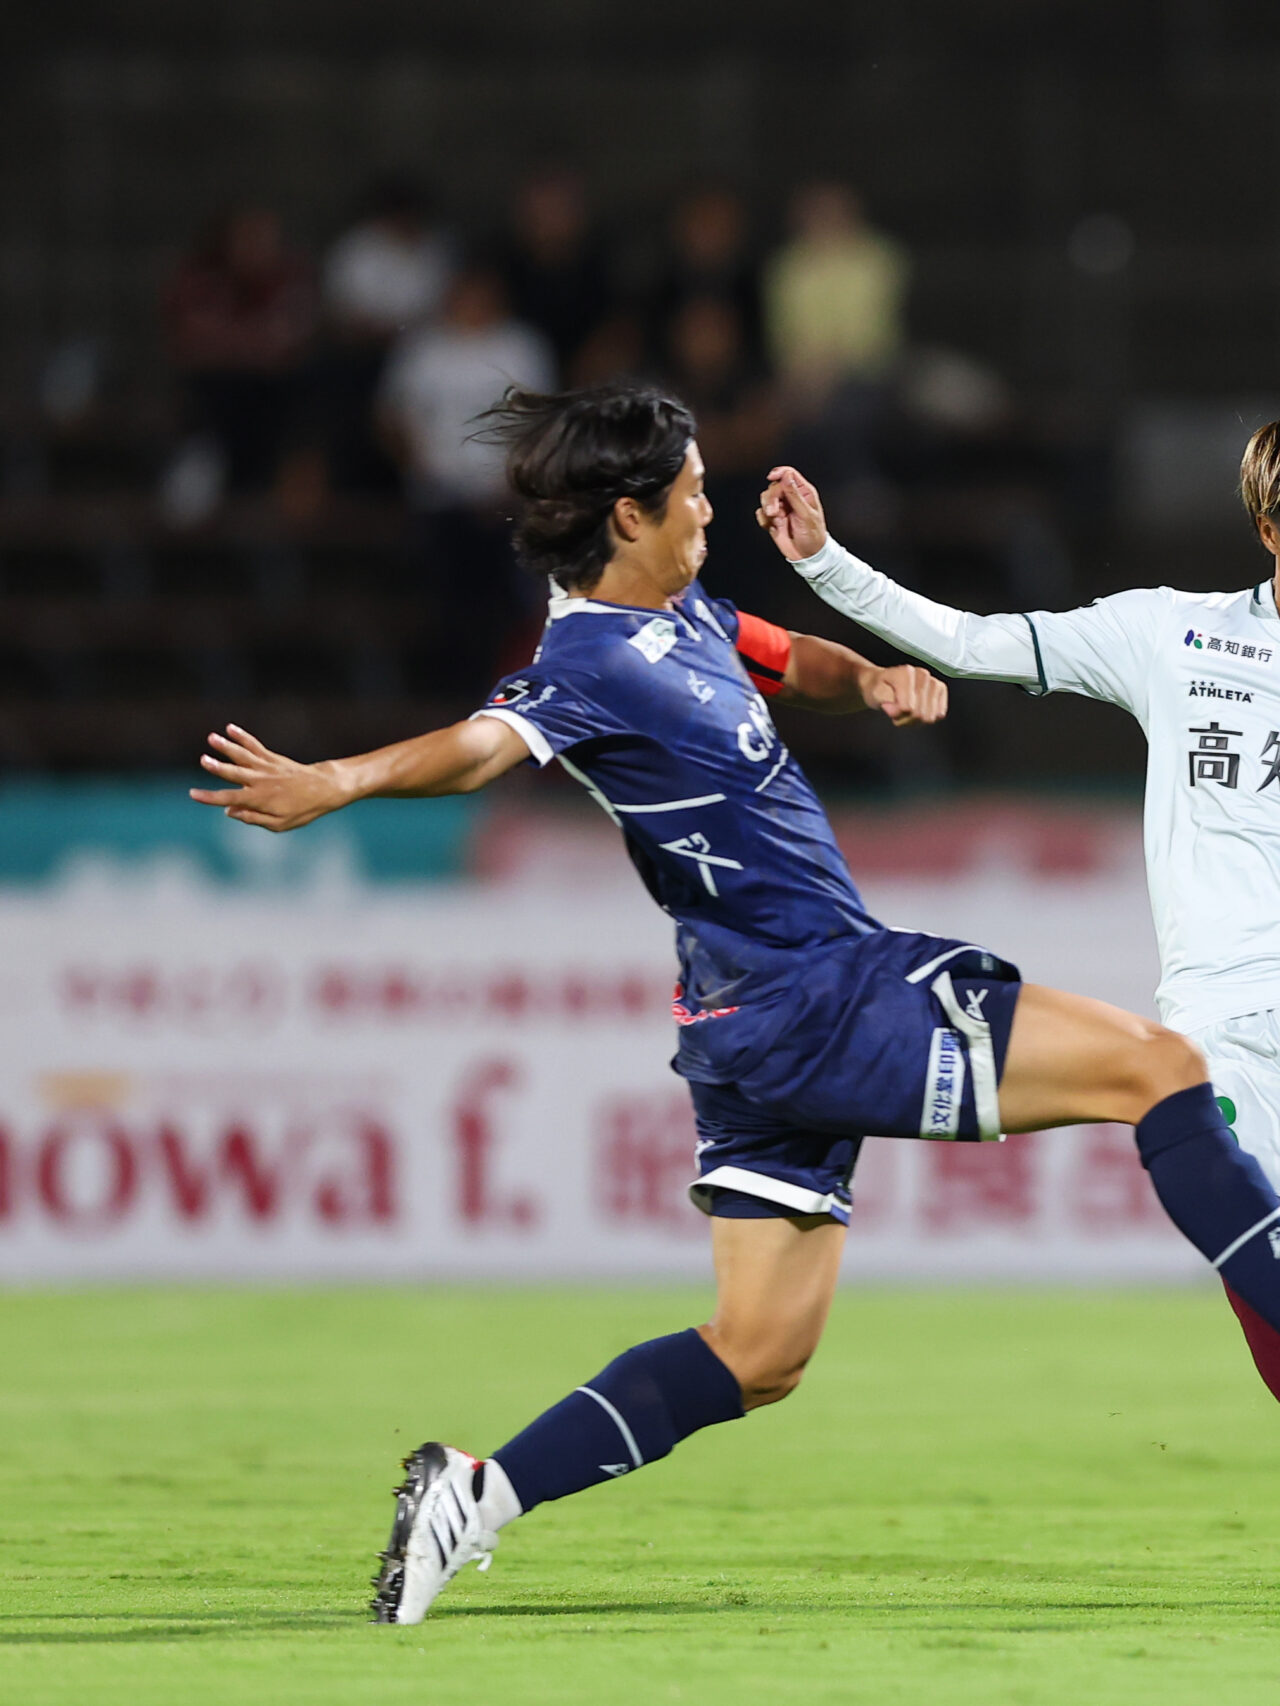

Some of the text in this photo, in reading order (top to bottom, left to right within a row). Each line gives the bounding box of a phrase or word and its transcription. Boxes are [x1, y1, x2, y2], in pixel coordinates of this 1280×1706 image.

[1207, 636, 1273, 663] 高知銀行
[1188, 686, 1252, 703] ATHLETA
[0, 1106, 398, 1234] owa
